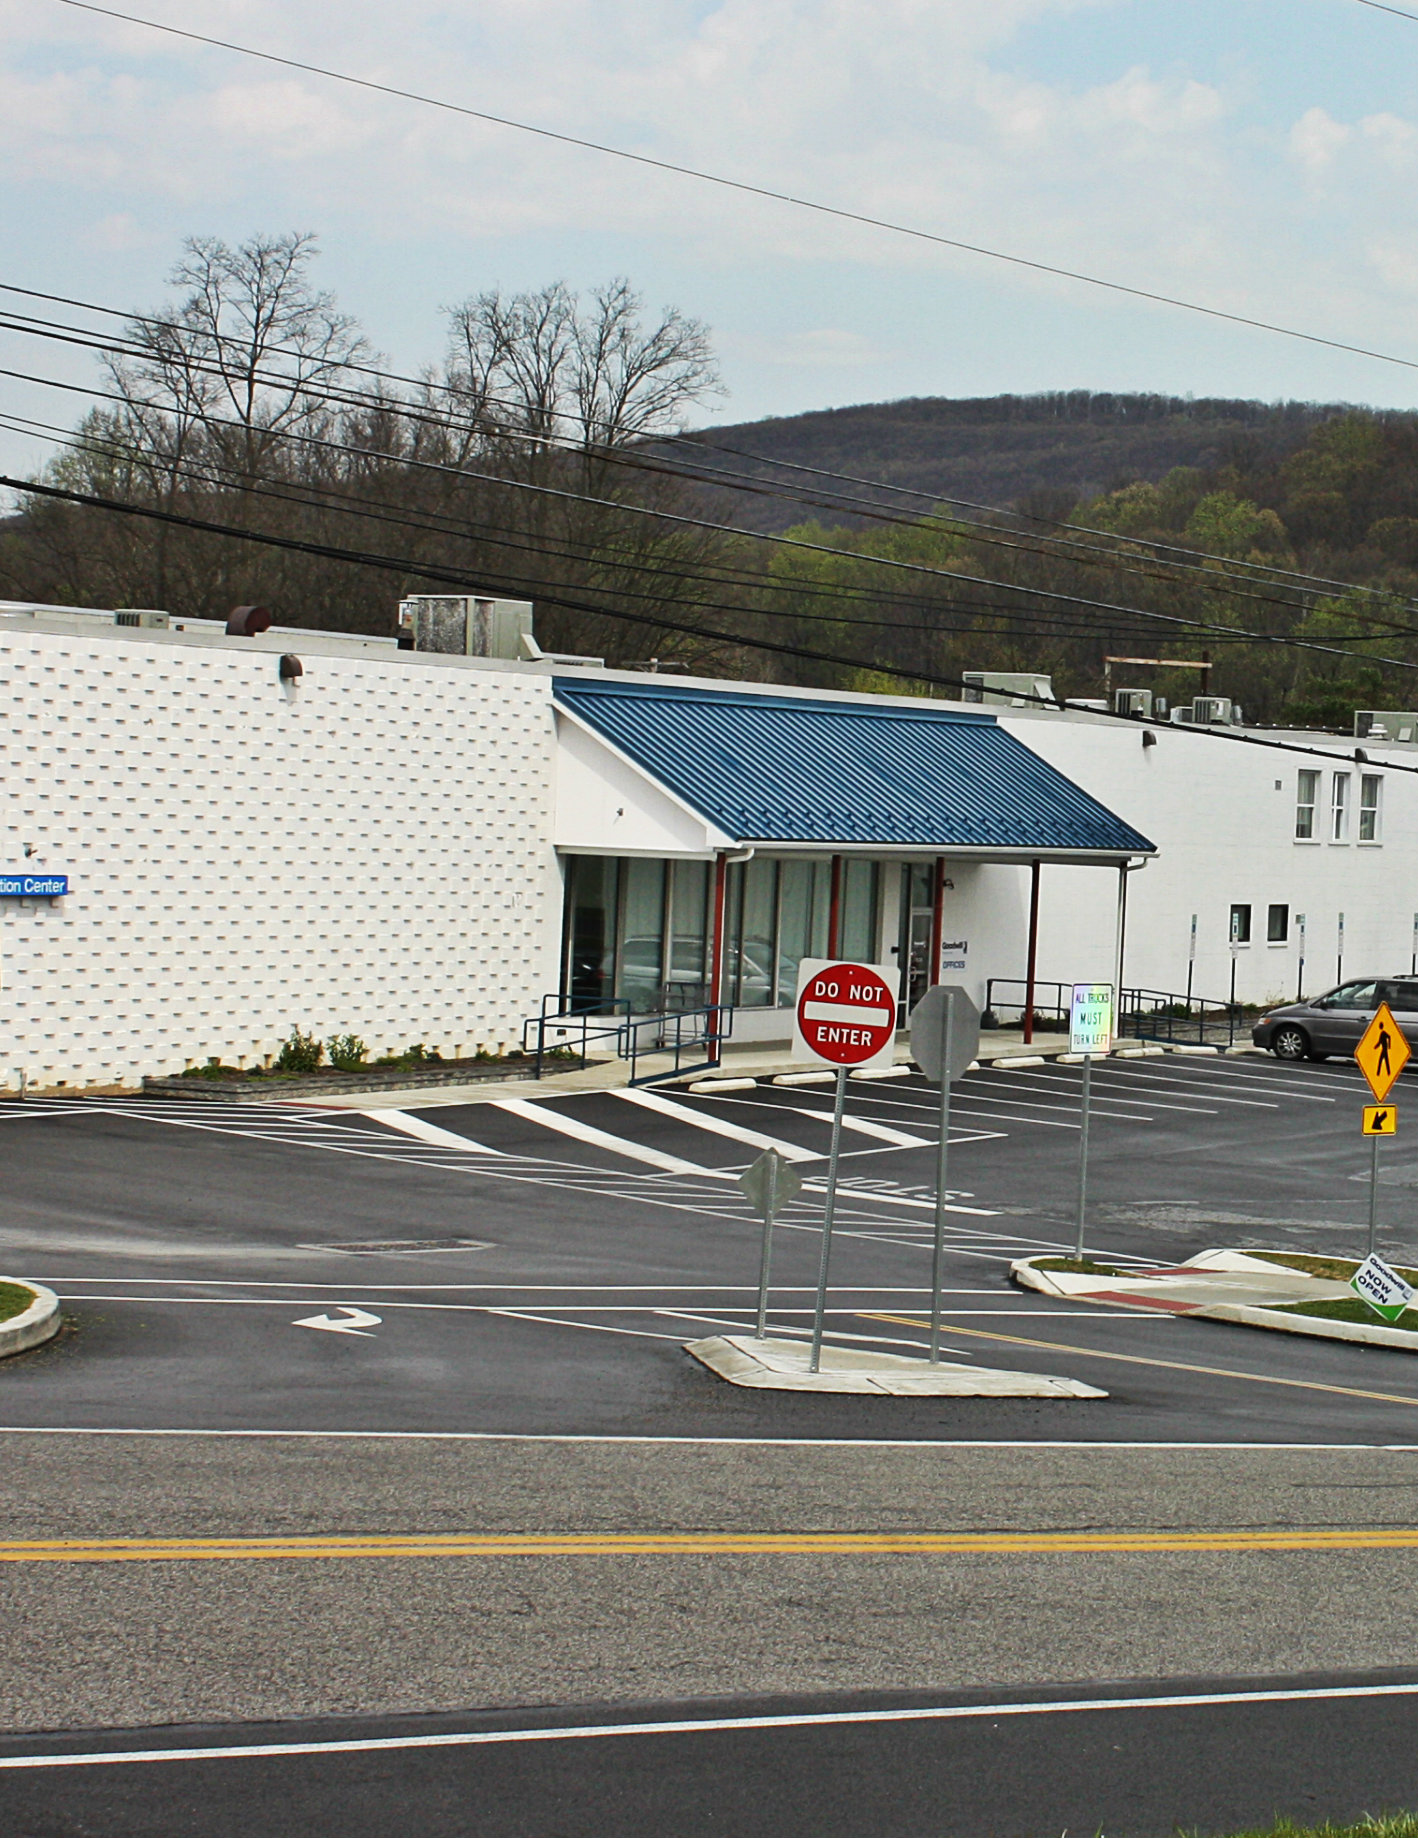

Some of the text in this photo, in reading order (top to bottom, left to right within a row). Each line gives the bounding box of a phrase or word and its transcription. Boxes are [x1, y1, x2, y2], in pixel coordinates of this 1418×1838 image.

[24, 878, 66, 893] Center
[815, 981, 884, 1003] DO NOT
[1075, 993, 1085, 1003] ALL
[1080, 1012, 1102, 1025] MUST
[816, 1026, 872, 1047] ENTER
[1074, 1033, 1108, 1045] TURN LEFT
[1365, 1269, 1392, 1294] NOW
[1370, 1257, 1406, 1291] Goodwill
[1357, 1275, 1389, 1304] OPEN
